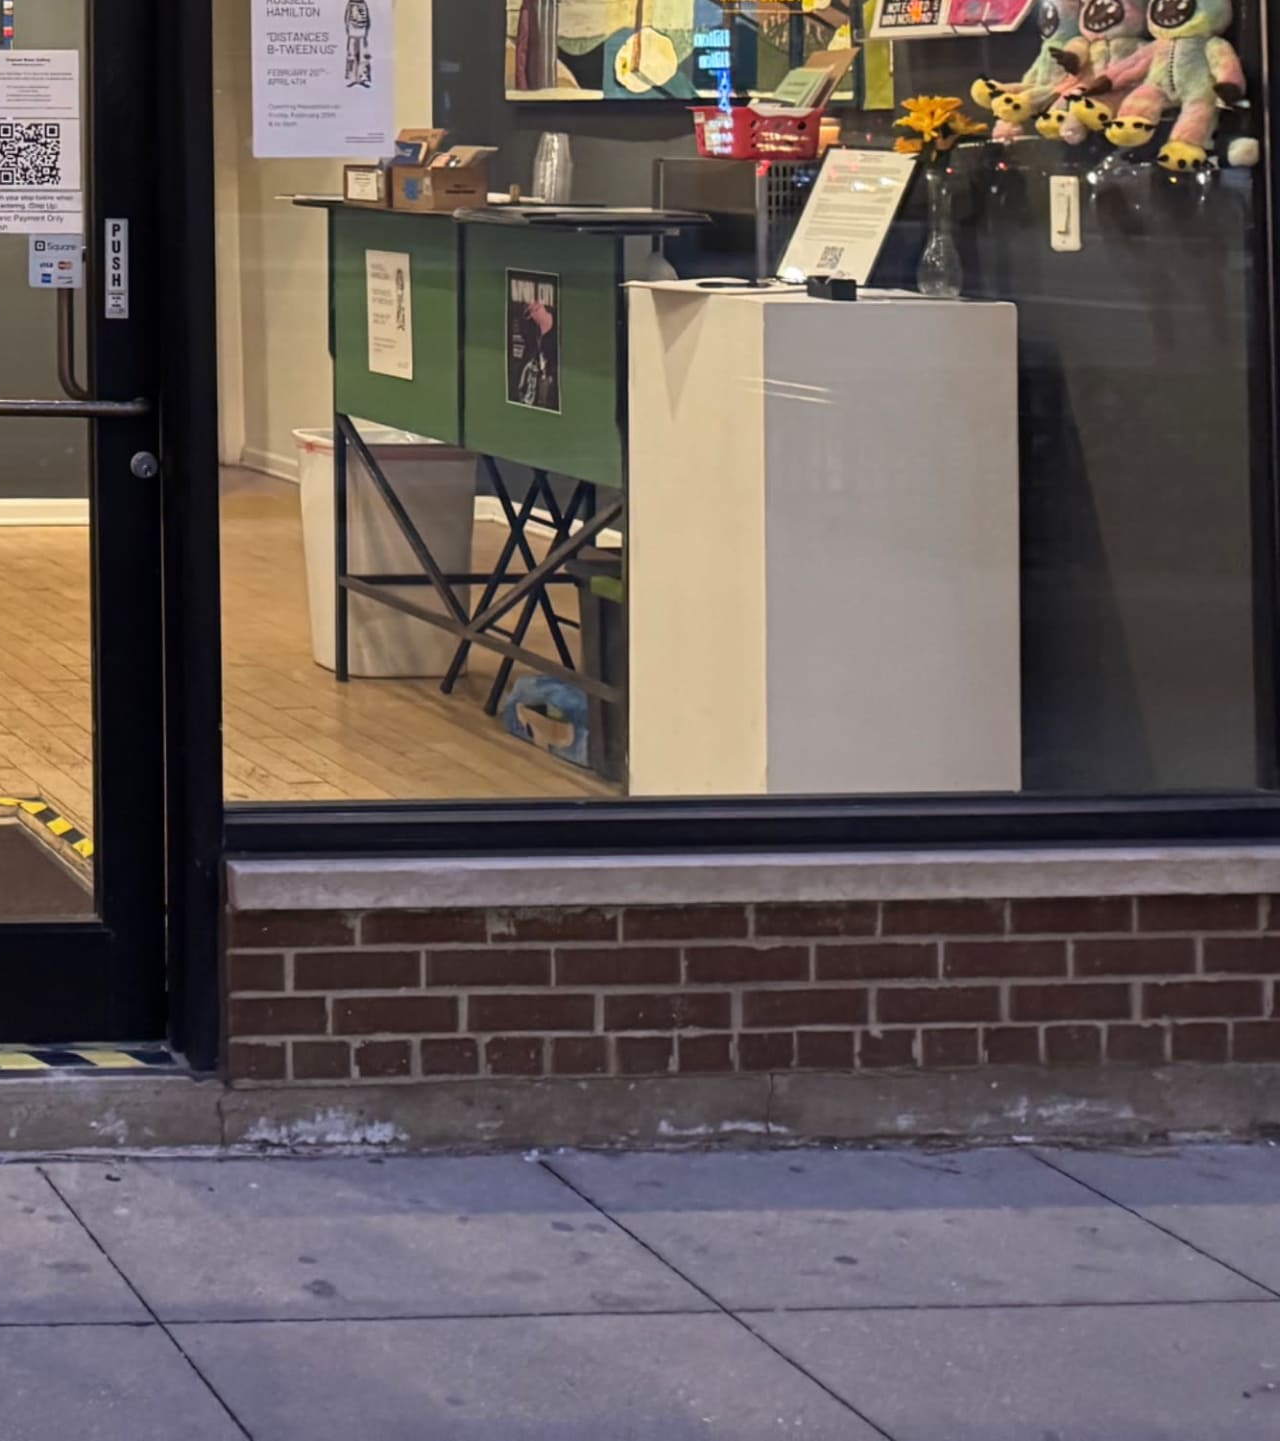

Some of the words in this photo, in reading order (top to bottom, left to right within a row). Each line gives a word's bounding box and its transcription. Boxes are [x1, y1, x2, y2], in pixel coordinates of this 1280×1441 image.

[266, 7, 320, 17] HAMILTON
[266, 44, 317, 55] B-TWEEN
[13, 214, 45, 223] Payment
[47, 214, 64, 224] Only
[112, 223, 122, 287] PUSH
